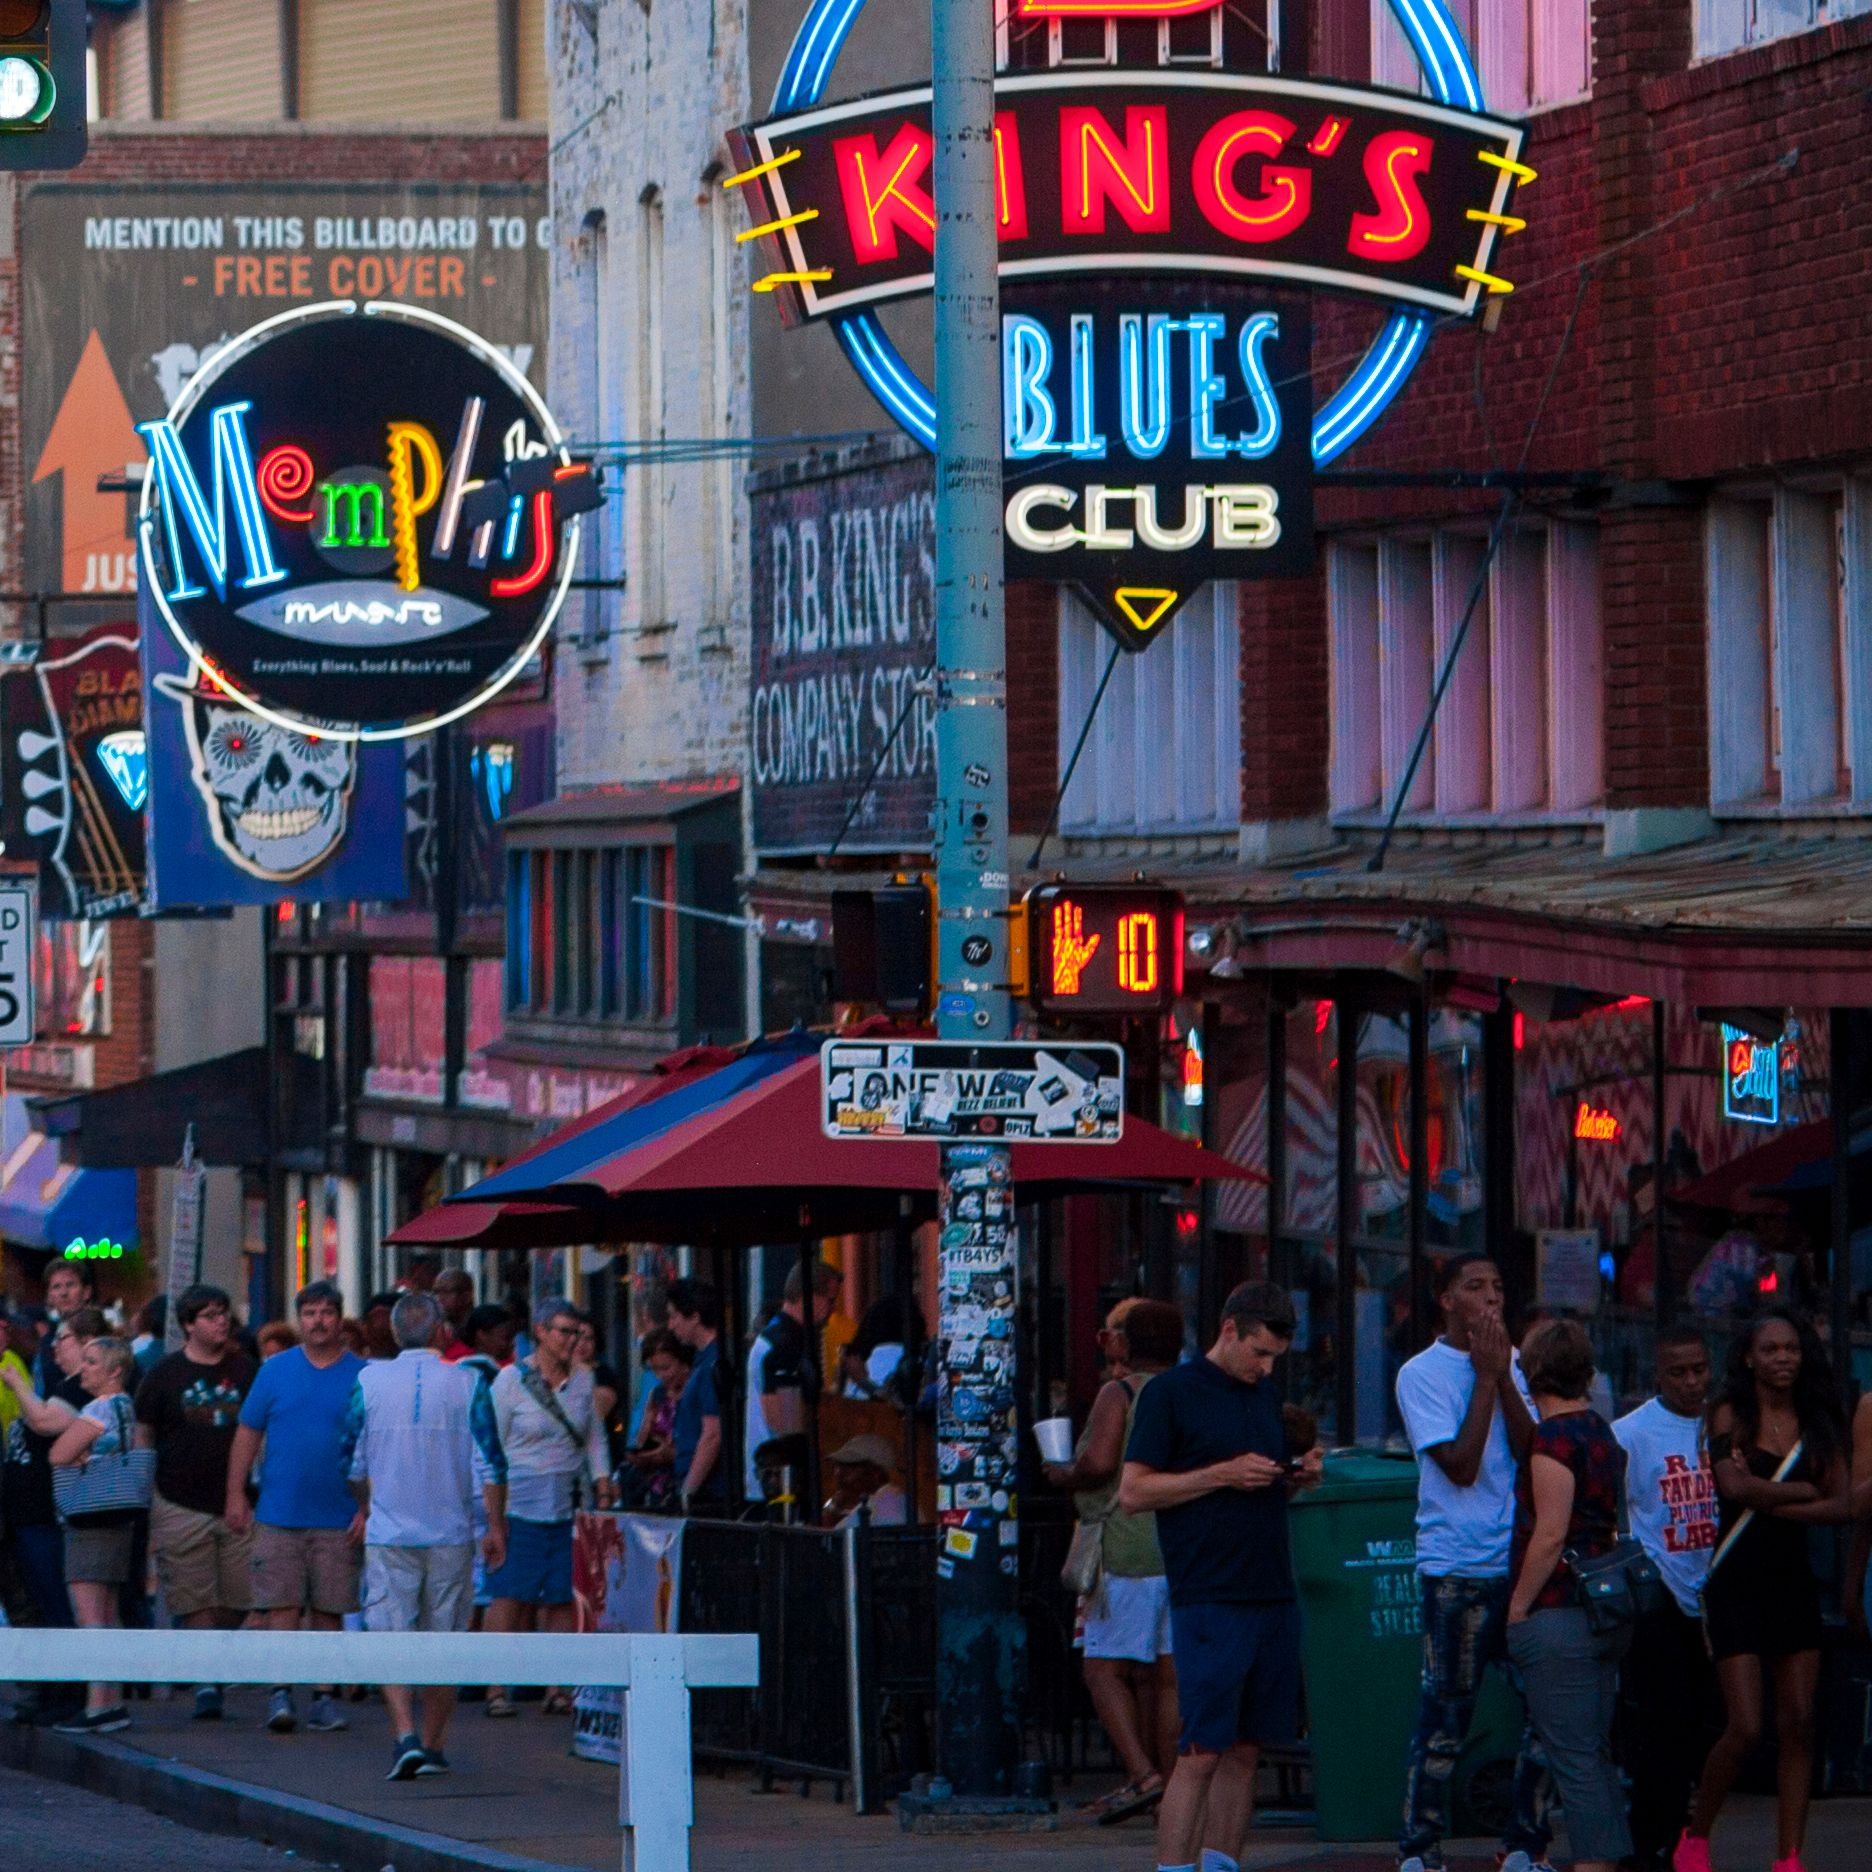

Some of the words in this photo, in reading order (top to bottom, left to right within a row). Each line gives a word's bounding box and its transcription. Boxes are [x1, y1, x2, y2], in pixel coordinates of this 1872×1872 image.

[84, 217, 224, 250] MENTION
[233, 217, 305, 250] THIS
[313, 217, 478, 250] BILLBOARD
[488, 218, 527, 250] TO
[213, 256, 314, 297] FREE
[328, 256, 466, 297] COVER
[1002, 312, 1282, 461] BLUES
[1004, 483, 1282, 552] CLUB
[283, 600, 443, 626] music
[754, 672, 864, 786] COMPANY
[870, 665, 937, 780] STOR
[1118, 913, 1157, 992] 10
